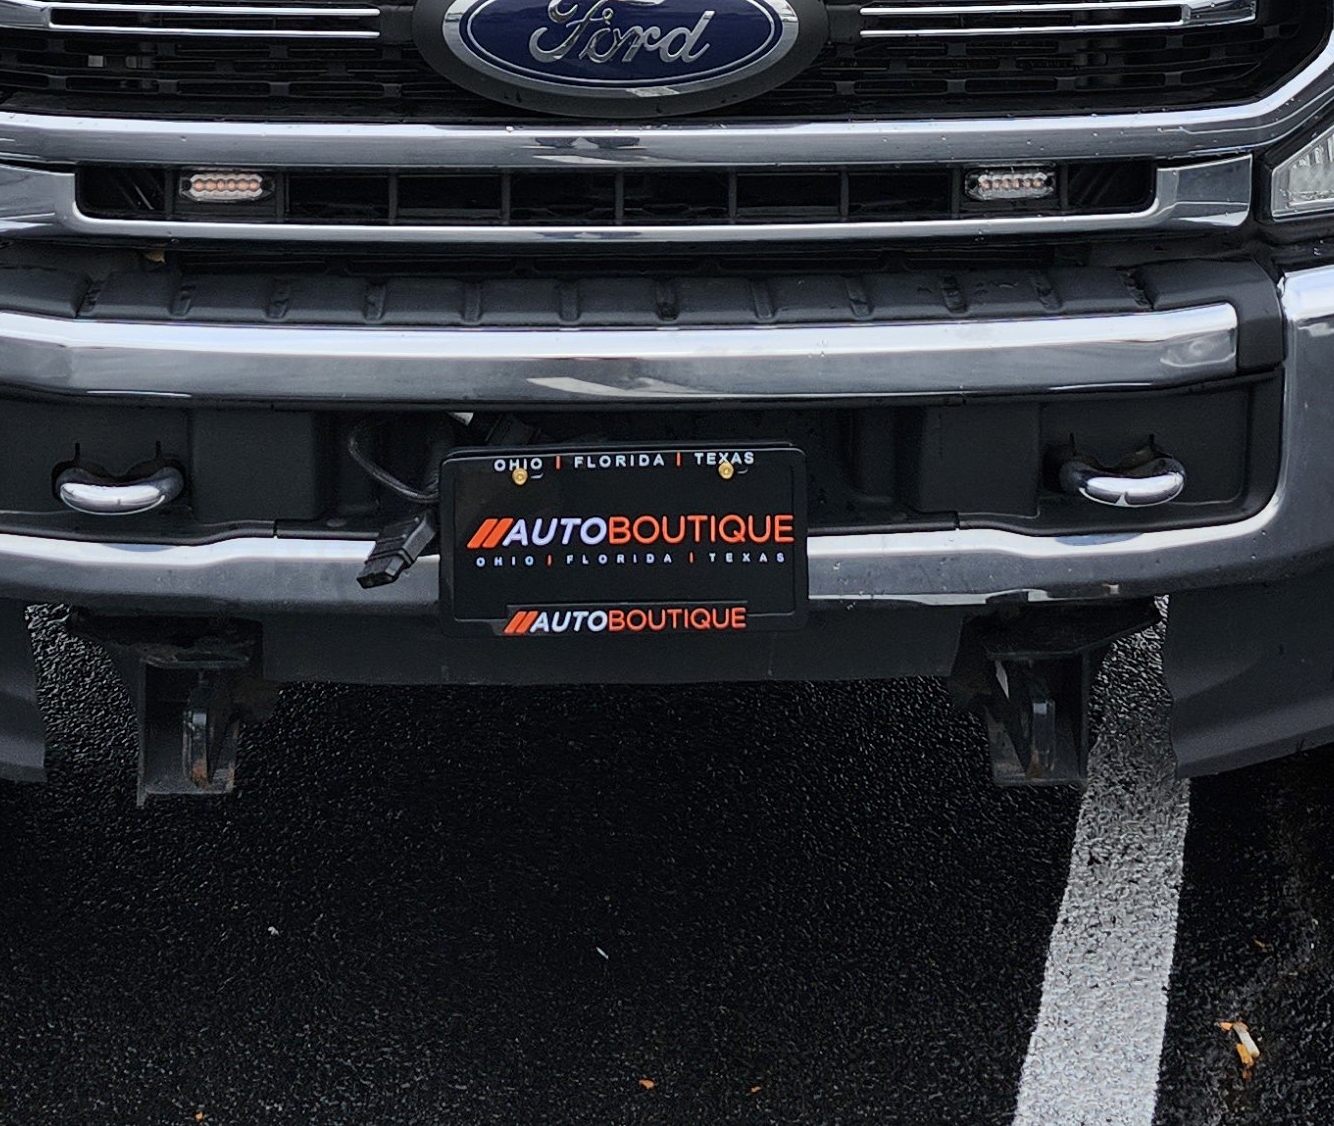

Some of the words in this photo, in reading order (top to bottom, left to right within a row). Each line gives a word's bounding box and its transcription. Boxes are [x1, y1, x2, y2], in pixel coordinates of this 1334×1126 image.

[493, 457, 543, 472] OHIO
[573, 453, 665, 469] FLORIDA
[693, 451, 755, 466] TEXAS
[475, 555, 534, 567] OHIO
[566, 553, 672, 565] FLORIDA
[708, 551, 784, 563] TEXAS
